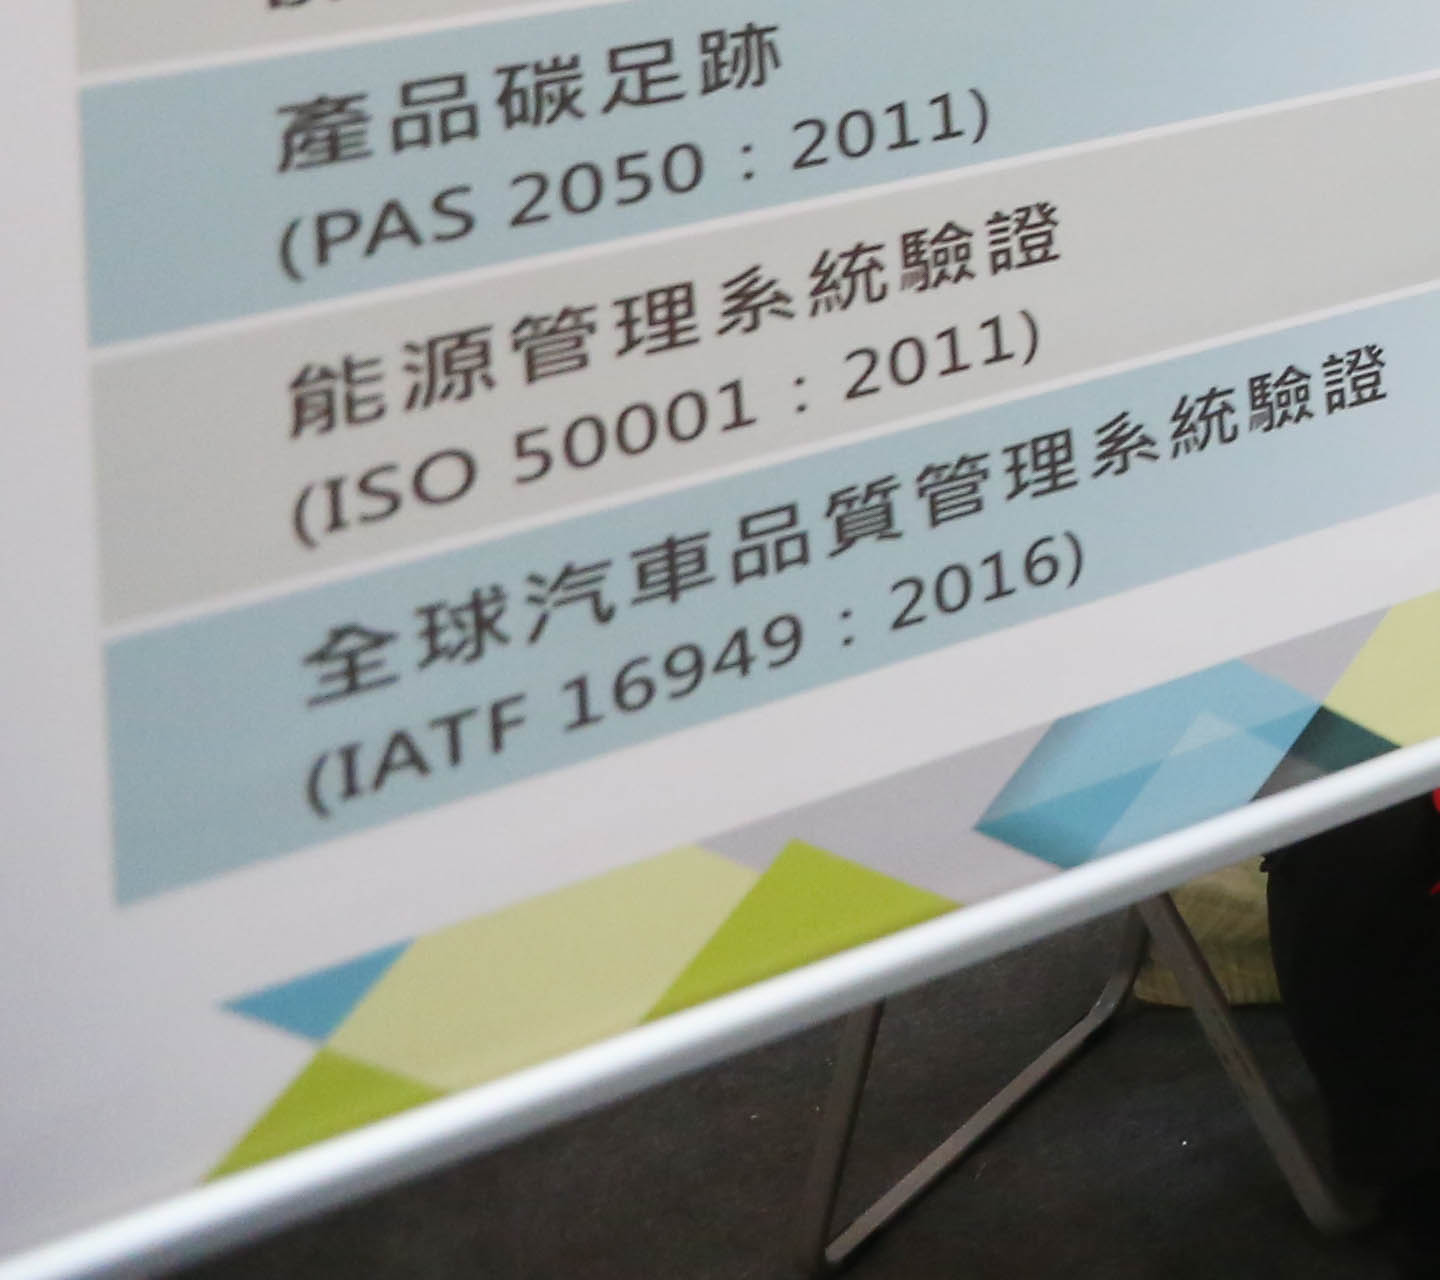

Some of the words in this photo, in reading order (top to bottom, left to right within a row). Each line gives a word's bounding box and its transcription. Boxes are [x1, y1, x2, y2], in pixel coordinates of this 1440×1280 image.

[274, 21, 783, 174] 產品碳足跡
[288, 201, 1062, 442] 能源管理系統驗證
[301, 344, 1389, 711] 全球汽車品質管理系統驗證
